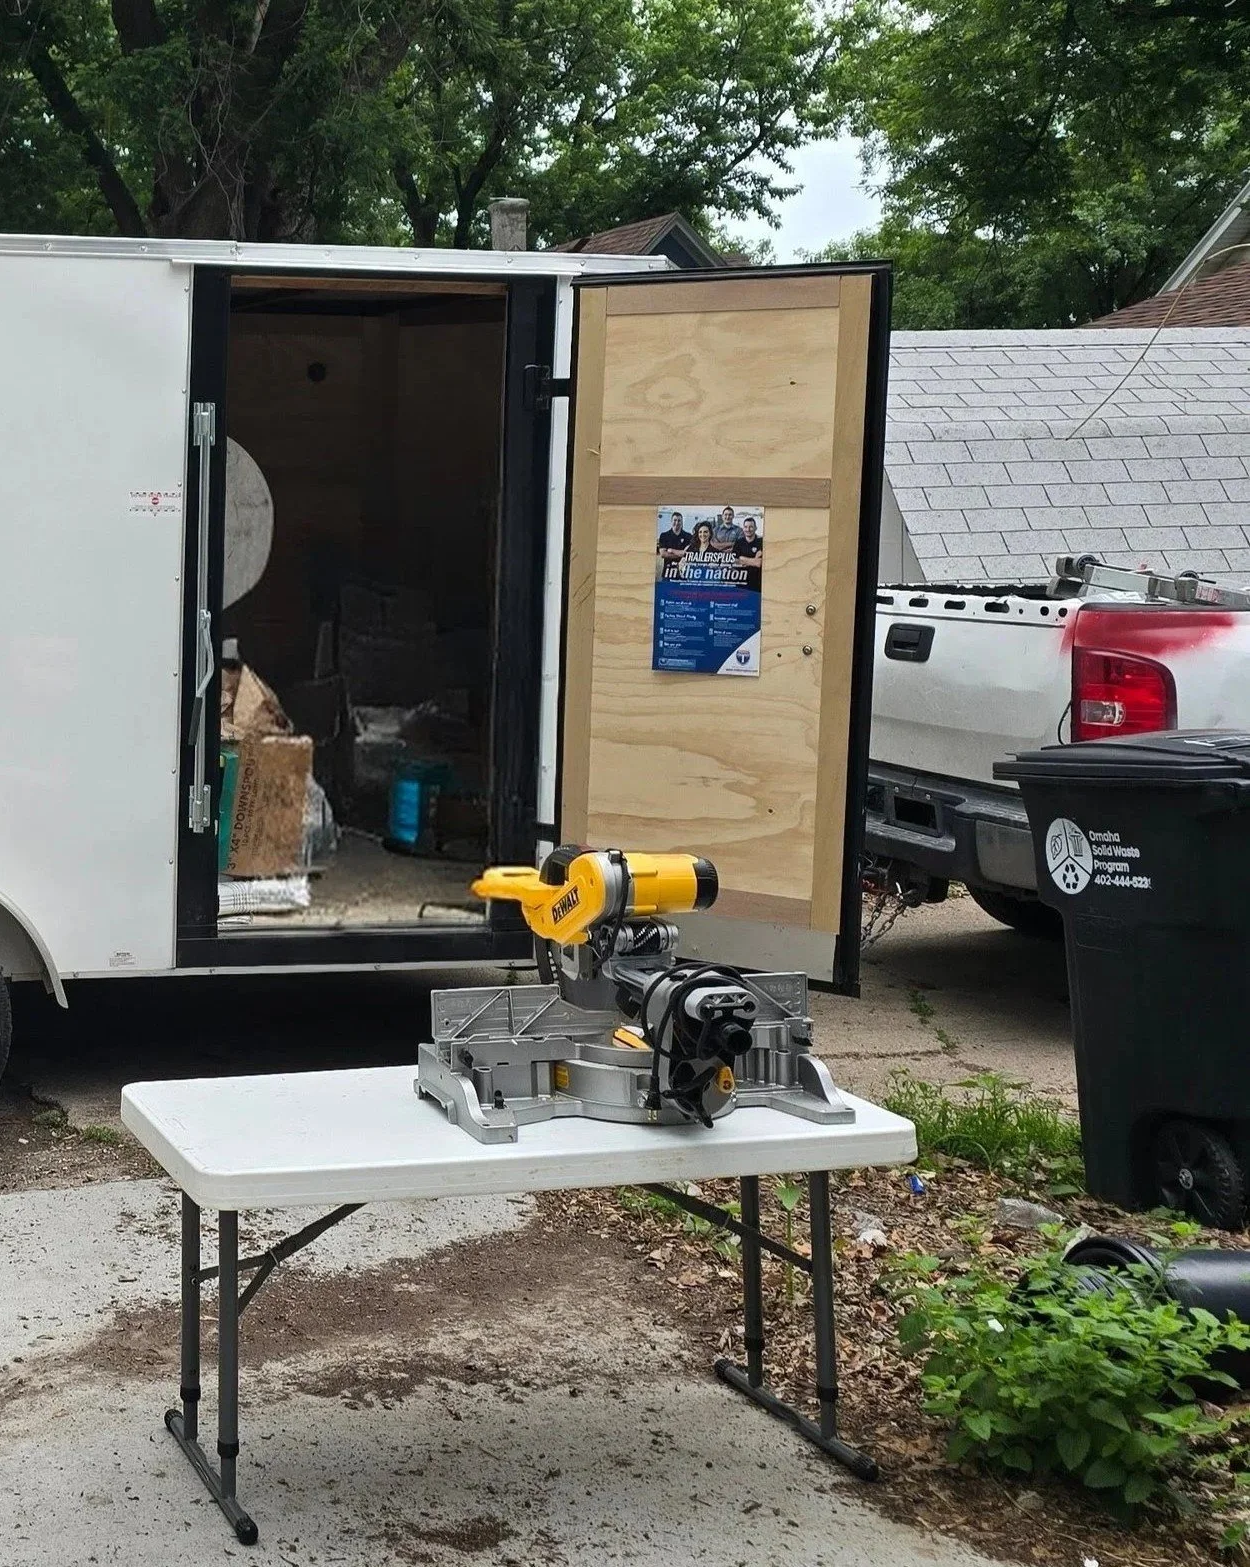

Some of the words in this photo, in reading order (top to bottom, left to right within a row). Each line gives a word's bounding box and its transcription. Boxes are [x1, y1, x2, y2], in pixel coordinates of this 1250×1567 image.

[685, 552, 737, 563] TRAILERSPLUS
[664, 566, 678, 578] in
[680, 564, 702, 579] the
[705, 567, 748, 581] nation
[1089, 830, 1120, 843] Omaha
[1091, 844, 1112, 857] Solid
[1113, 845, 1141, 858] Waste
[1094, 859, 1130, 873] Program
